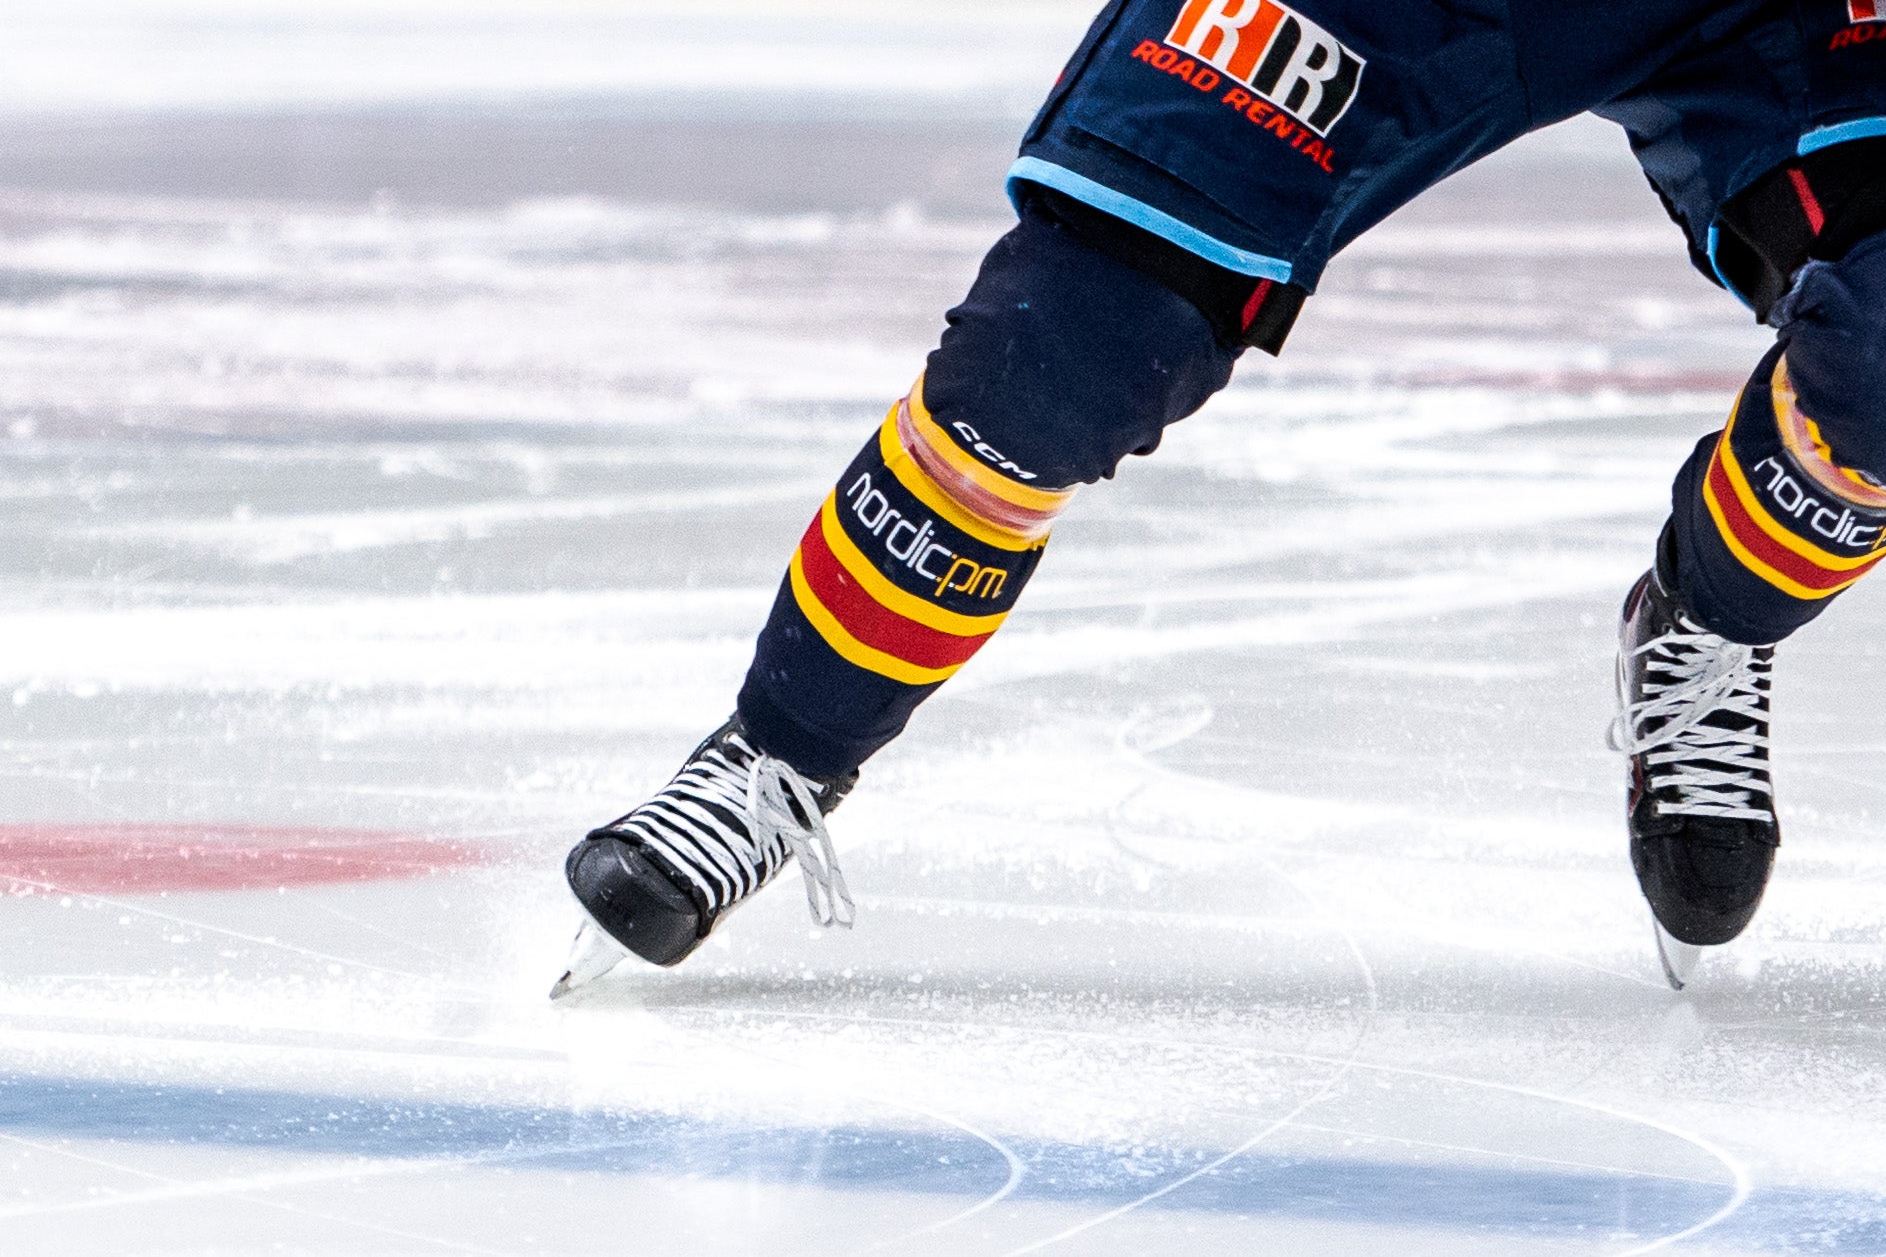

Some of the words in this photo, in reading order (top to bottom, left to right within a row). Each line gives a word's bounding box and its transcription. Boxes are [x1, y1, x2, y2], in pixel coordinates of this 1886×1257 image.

[1131, 39, 1222, 92] ROAD
[1221, 87, 1337, 174] RENTAL
[952, 421, 1038, 480] CCM
